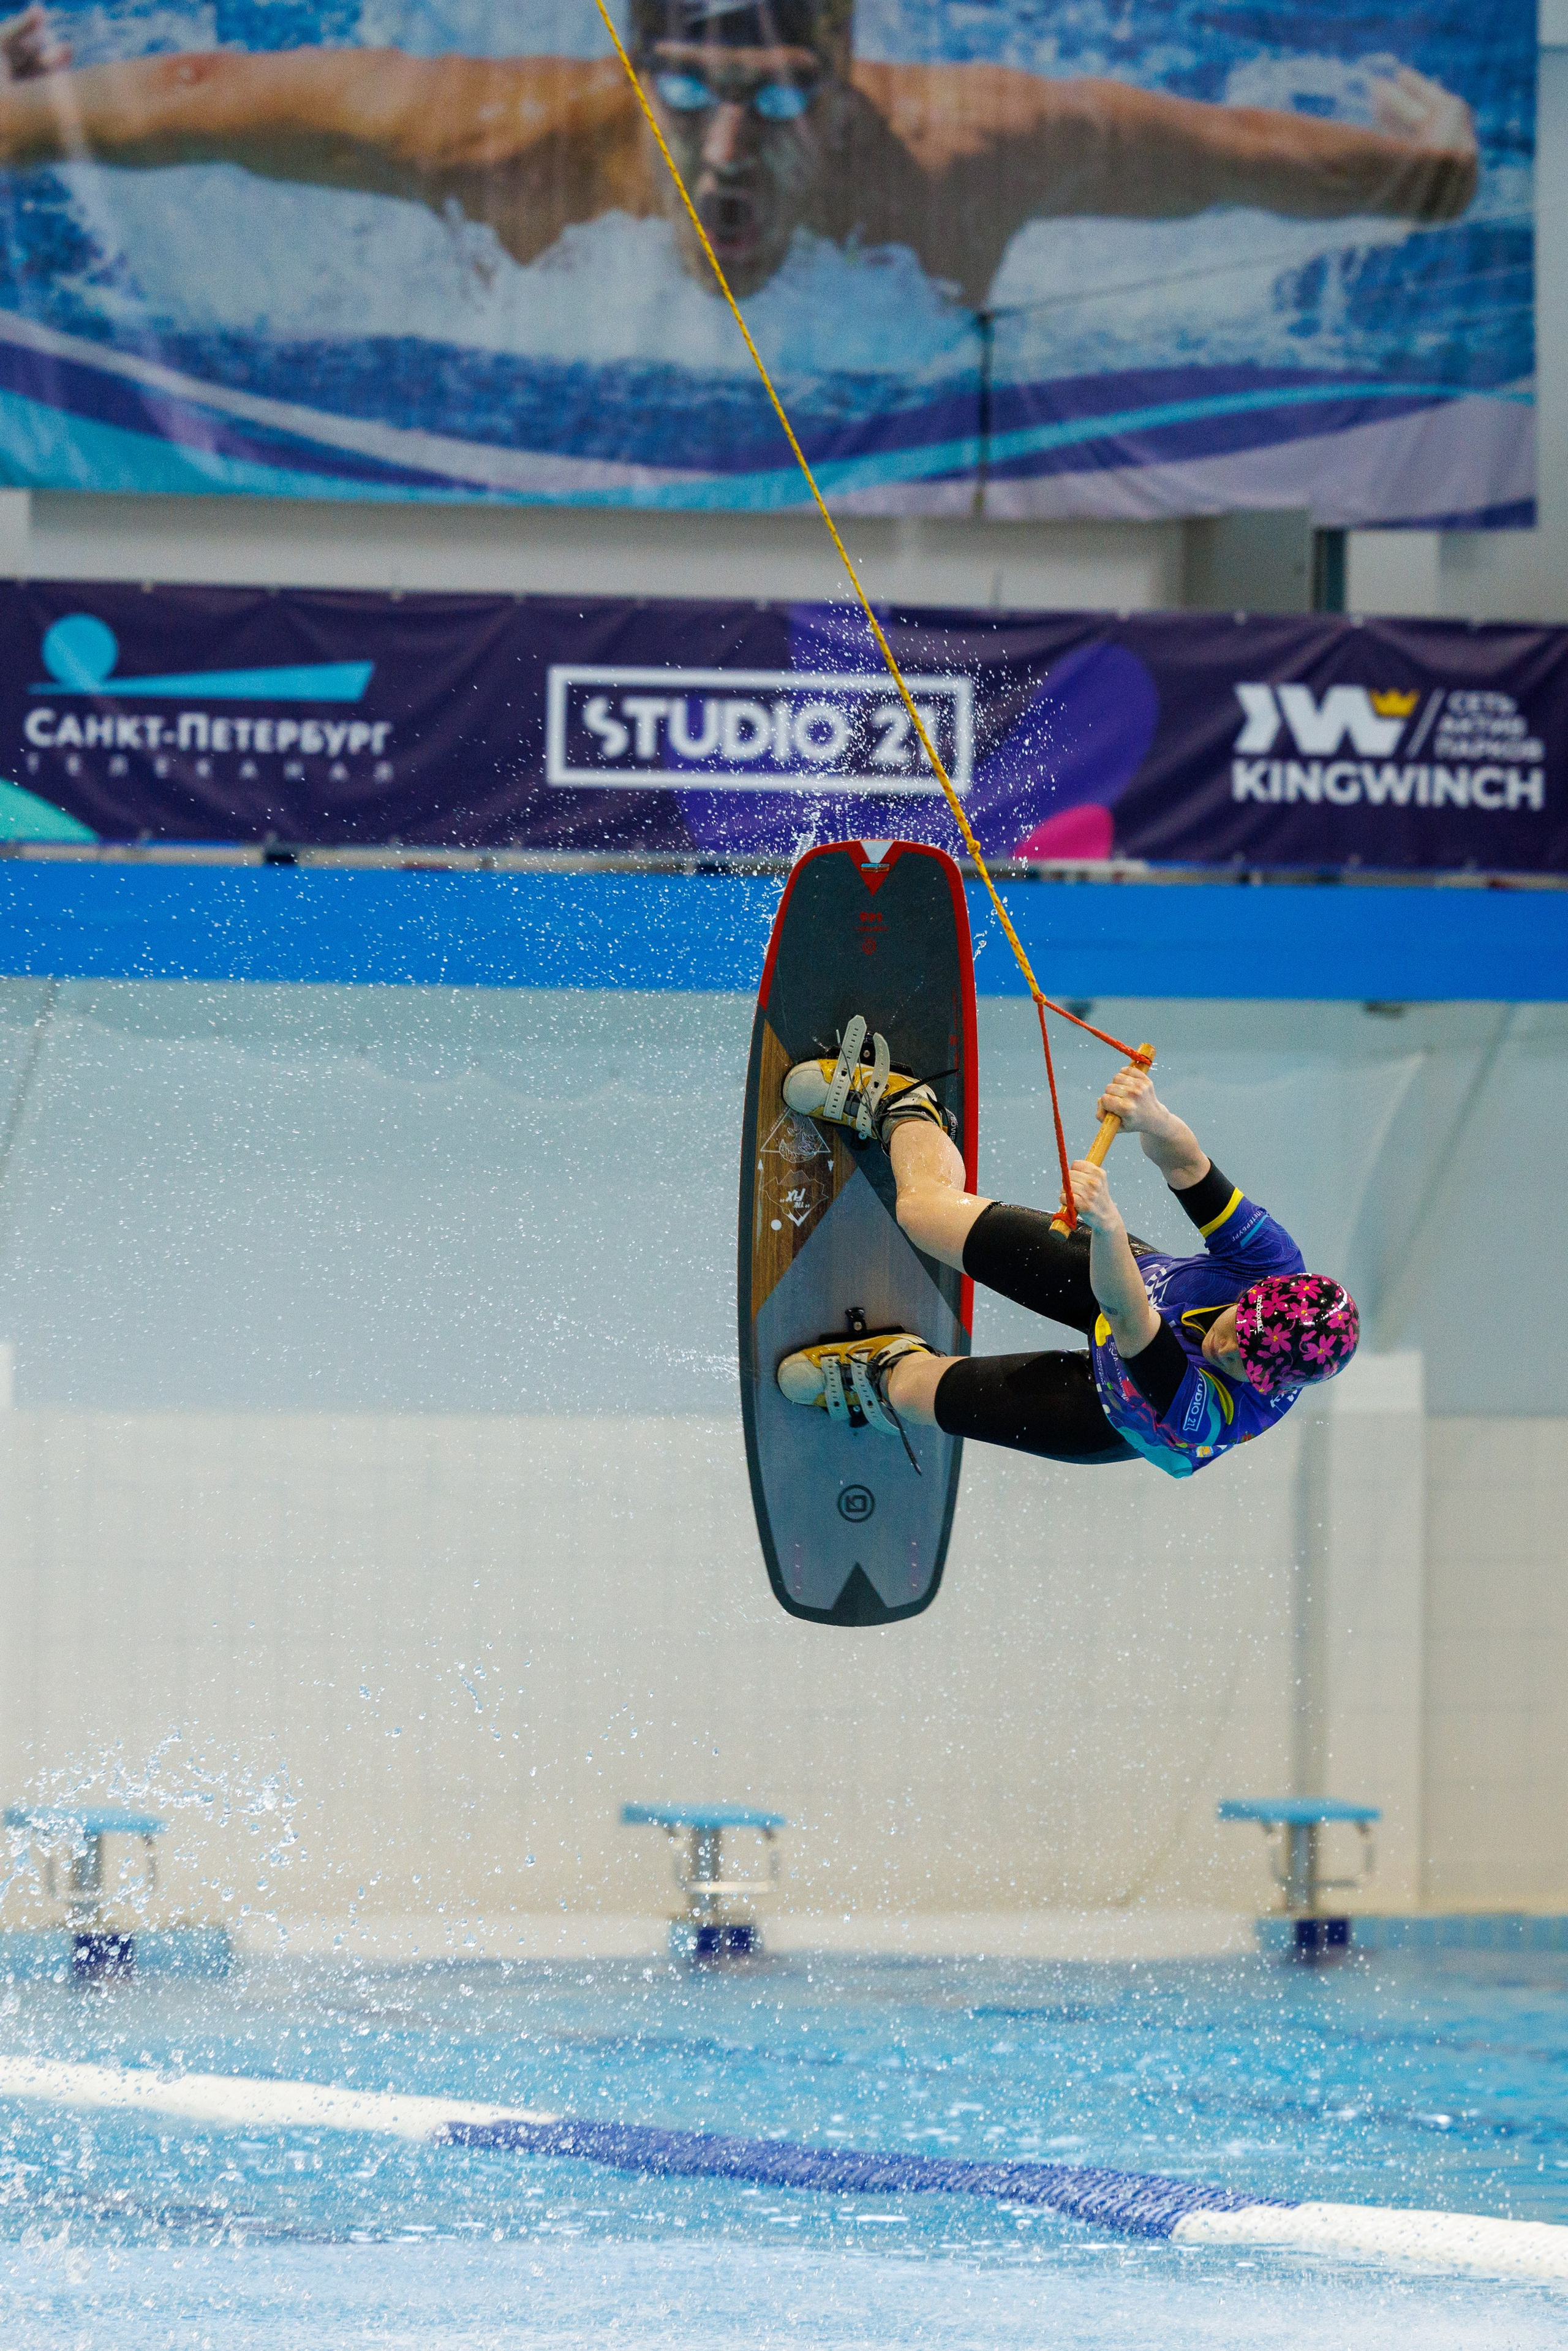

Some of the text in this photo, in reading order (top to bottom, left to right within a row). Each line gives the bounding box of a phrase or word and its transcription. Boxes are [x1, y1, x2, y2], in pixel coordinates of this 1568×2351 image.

[583, 696, 938, 766] STUDIO 21
[1232, 760, 1546, 812] KINGWINCH
[1187, 1417, 1197, 1427] 21
